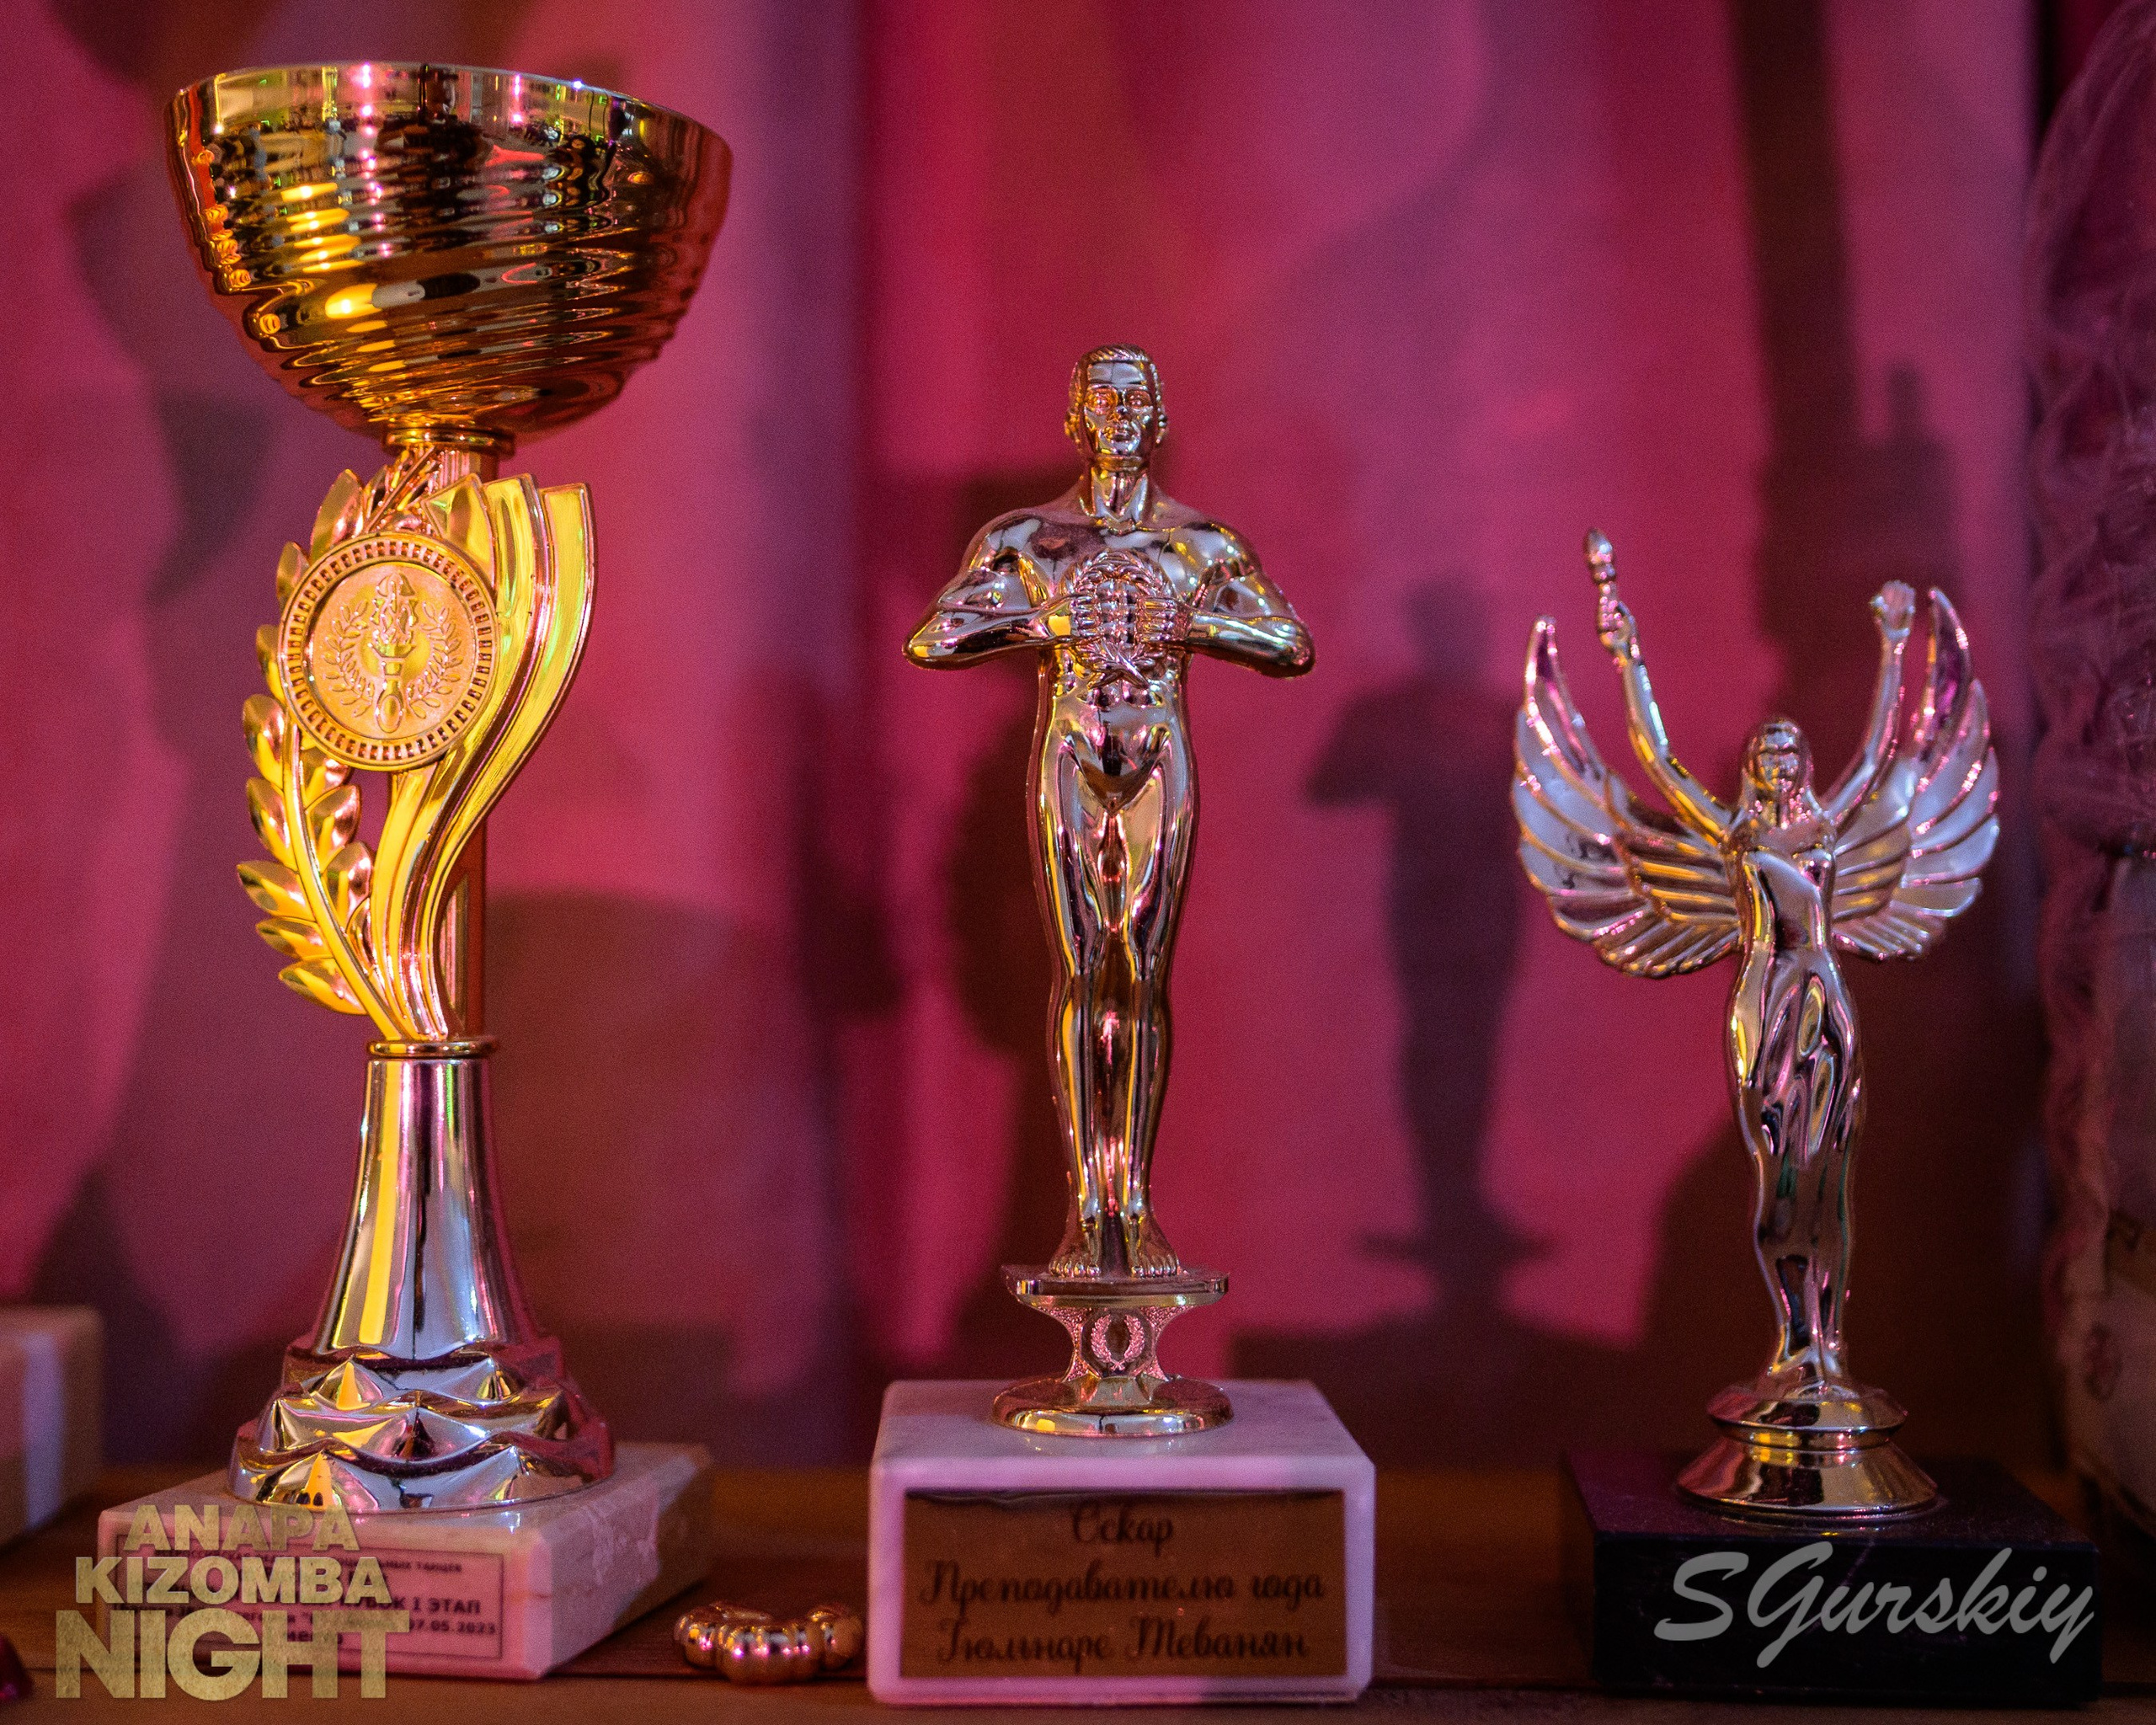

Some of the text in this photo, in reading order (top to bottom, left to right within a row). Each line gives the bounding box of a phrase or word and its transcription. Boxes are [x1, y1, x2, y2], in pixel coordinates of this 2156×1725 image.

[1070, 1501, 1174, 1557] Оскар
[428, 1597, 481, 1614] ЭТАП
[919, 1559, 1326, 1616] Преподавателю года
[937, 1615, 1310, 1674] Гюльнаре Теванян
